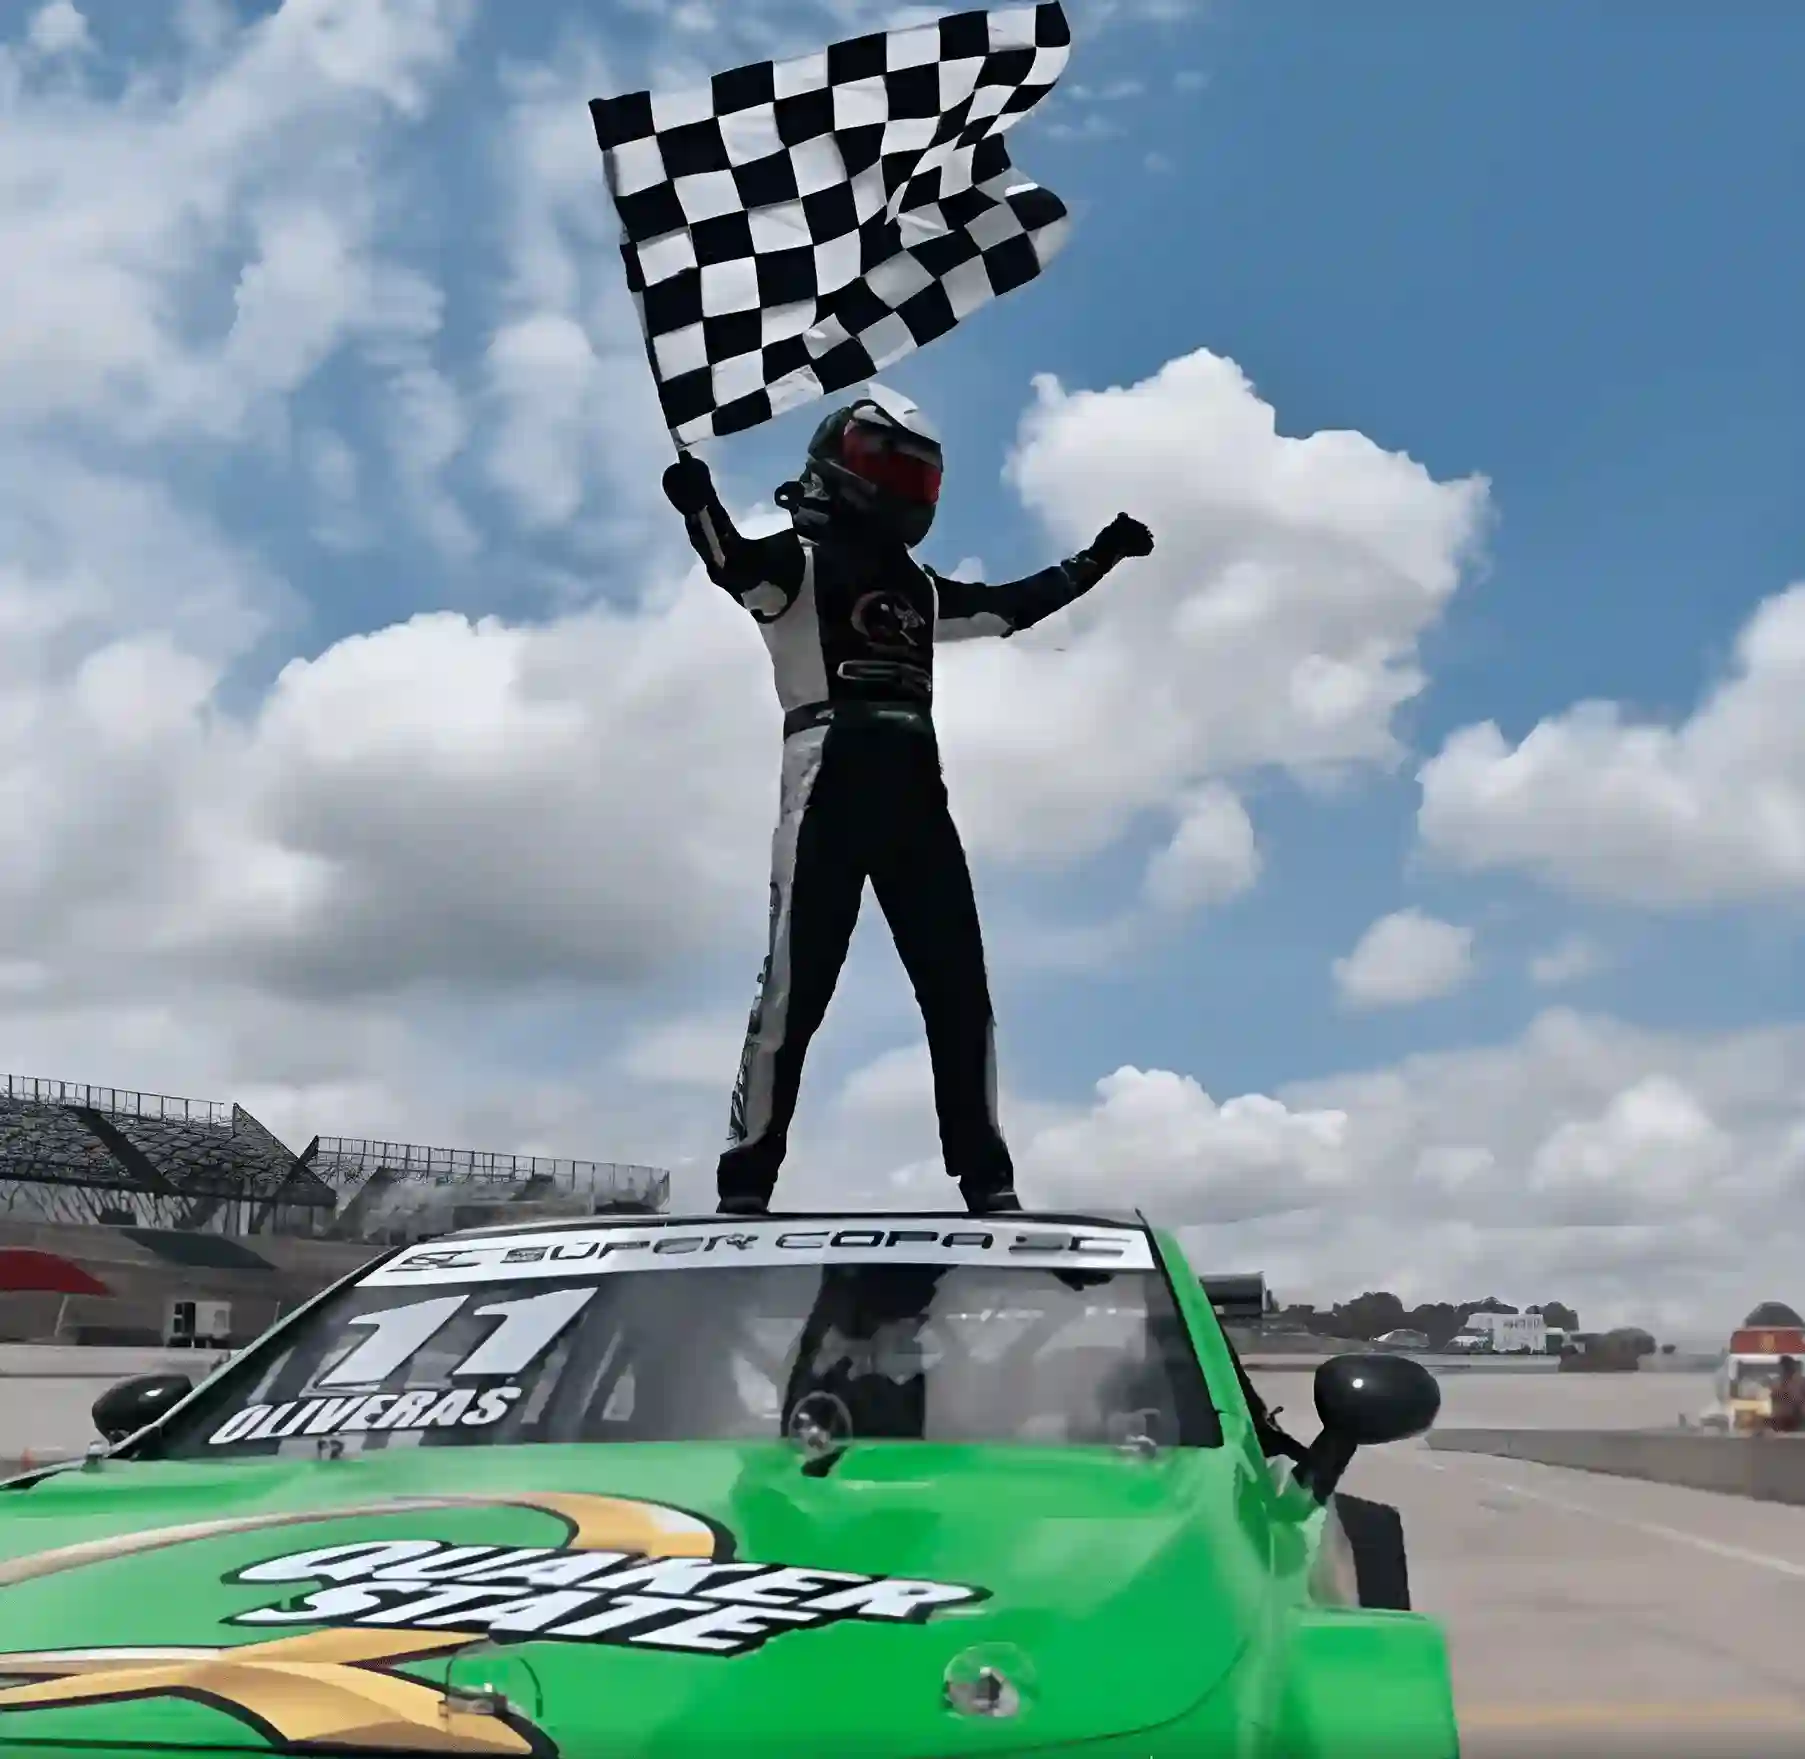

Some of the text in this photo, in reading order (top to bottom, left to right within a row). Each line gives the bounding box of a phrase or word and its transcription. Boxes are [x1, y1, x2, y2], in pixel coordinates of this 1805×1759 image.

[775, 1230, 994, 1249] COPA
[318, 1286, 599, 1387] 11
[207, 1386, 523, 1445] OLIVERAS
[236, 1538, 976, 1619] QUAKER
[233, 1580, 821, 1649] STATE
